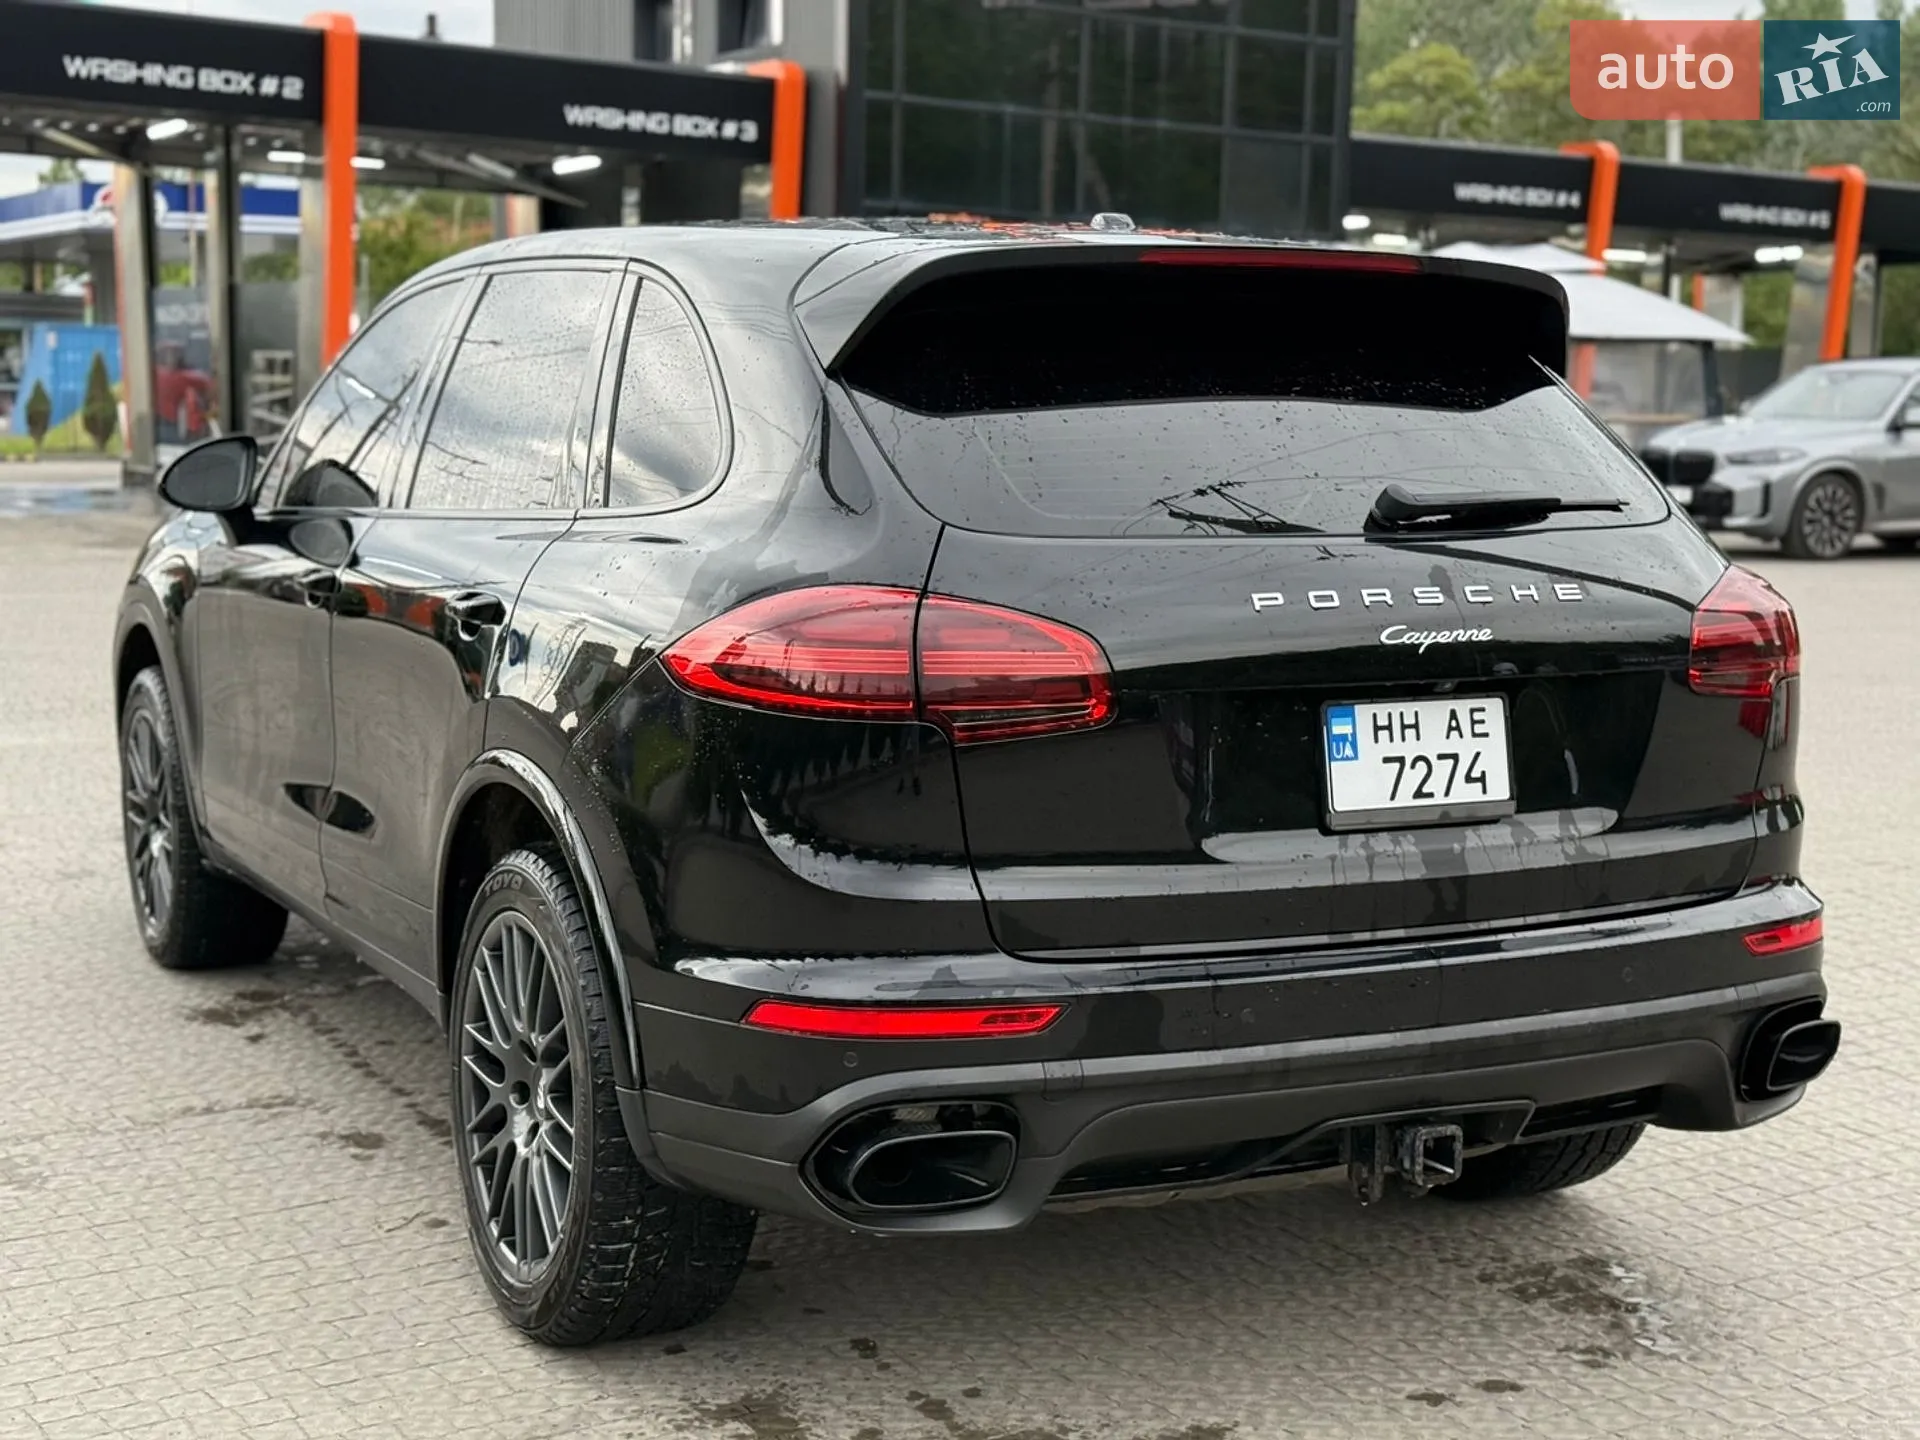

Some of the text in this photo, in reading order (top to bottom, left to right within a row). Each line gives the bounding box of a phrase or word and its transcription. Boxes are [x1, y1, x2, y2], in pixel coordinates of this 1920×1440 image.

[63, 55, 194, 89] WASHING
[198, 68, 255, 94] BOX
[564, 105, 670, 134] WASHING
[671, 114, 719, 137] BOX
[1251, 583, 1584, 613] PORSCHE
[1380, 625, 1494, 654] Cayenne
[1372, 706, 1490, 744] HH AE
[1332, 741, 1355, 759] UA
[1382, 750, 1488, 802] 7274
